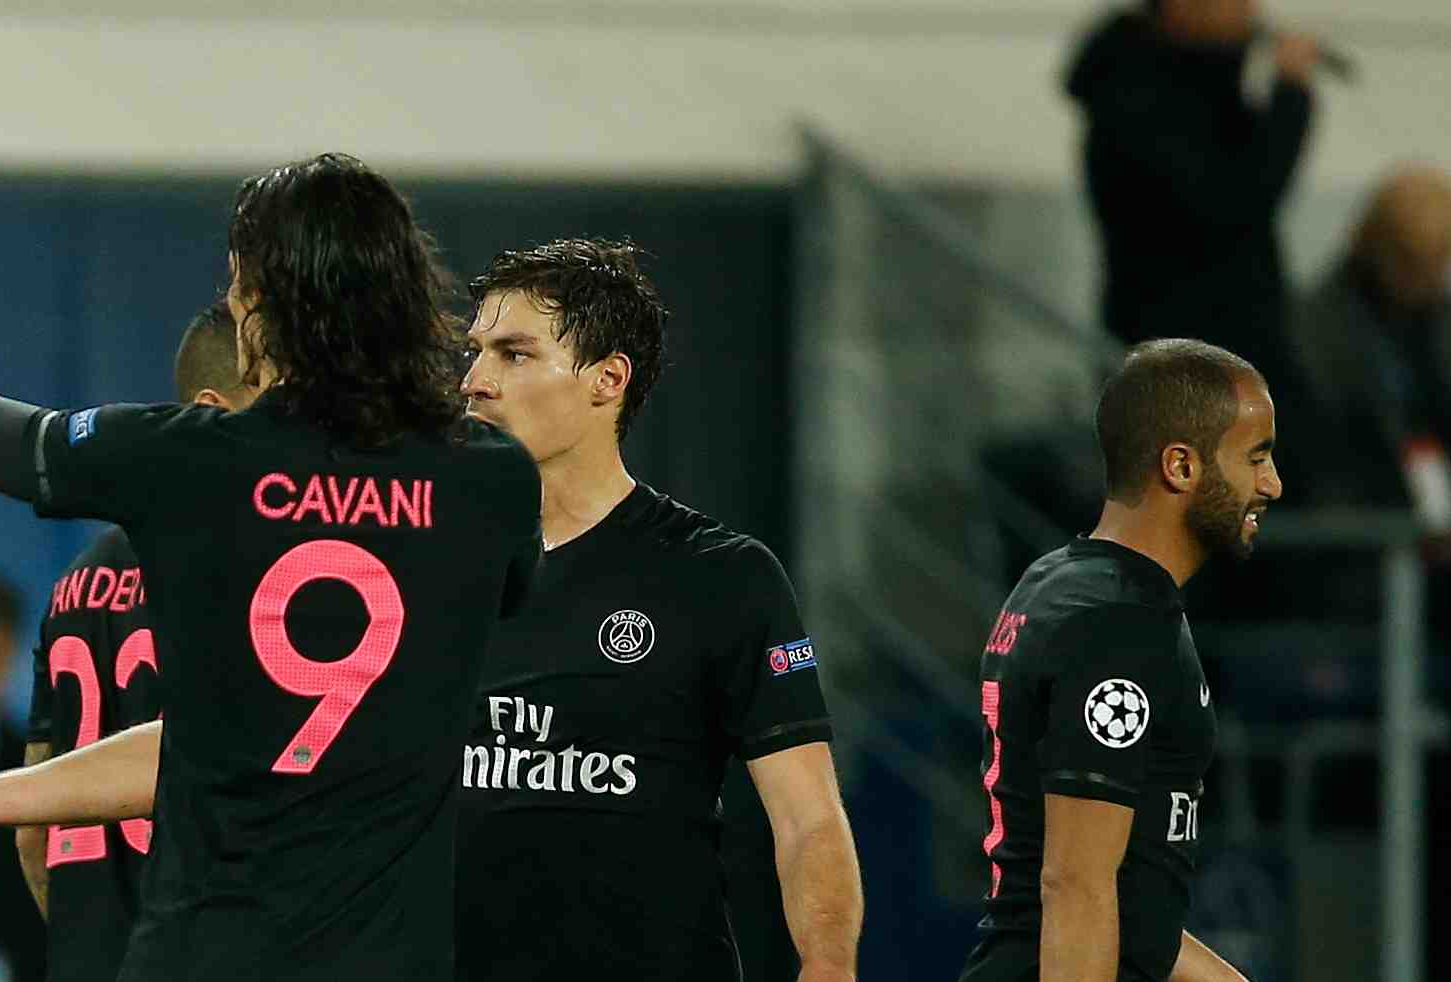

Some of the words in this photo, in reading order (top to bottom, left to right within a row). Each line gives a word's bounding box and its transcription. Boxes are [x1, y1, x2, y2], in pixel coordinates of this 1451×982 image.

[252, 472, 434, 529] CAVANI
[50, 567, 89, 618] AN
[611, 612, 648, 628] PARIS
[249, 539, 405, 774] 9
[488, 696, 554, 742] Fly
